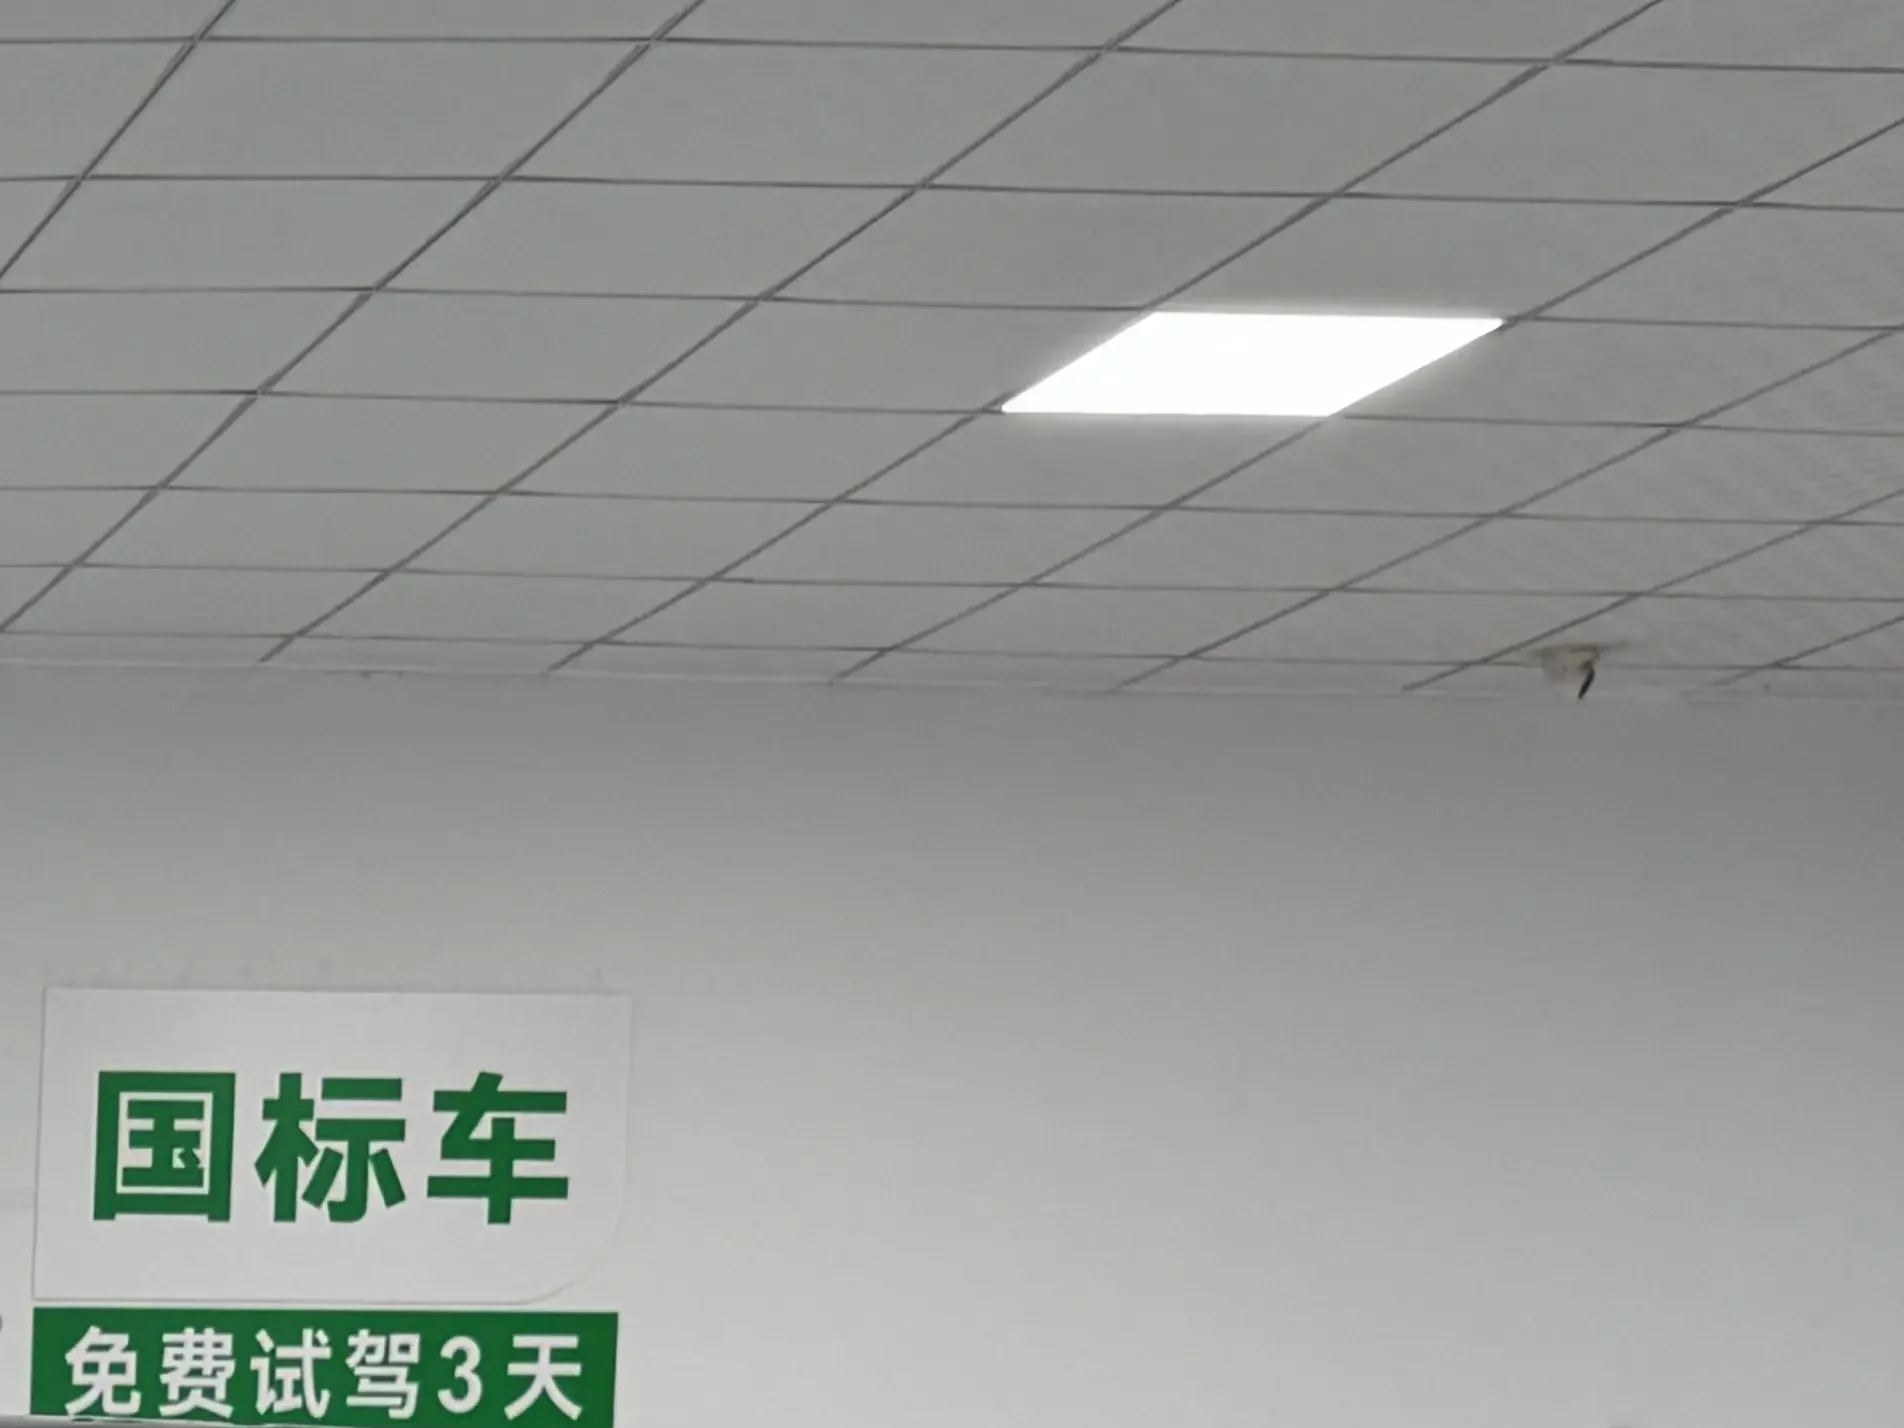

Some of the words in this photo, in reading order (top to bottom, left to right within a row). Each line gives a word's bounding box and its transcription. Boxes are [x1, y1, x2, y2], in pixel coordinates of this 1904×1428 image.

[93, 1071, 569, 1225] 国标车
[64, 1326, 583, 1421] 免费试驾3天
